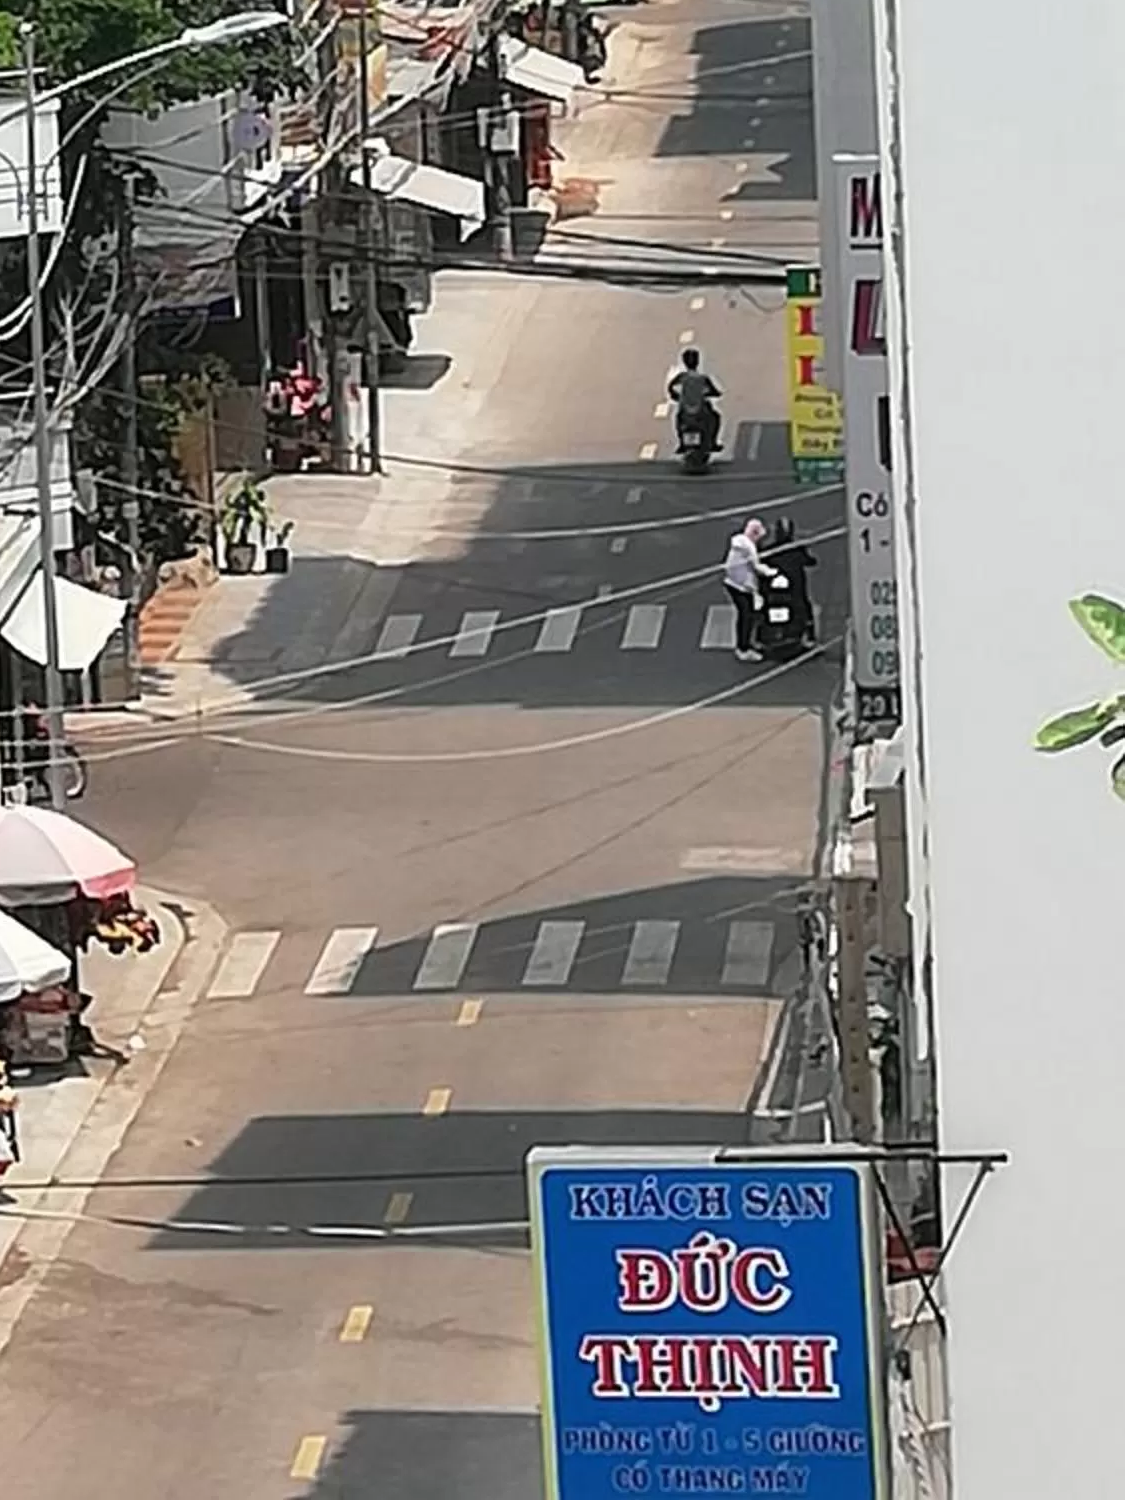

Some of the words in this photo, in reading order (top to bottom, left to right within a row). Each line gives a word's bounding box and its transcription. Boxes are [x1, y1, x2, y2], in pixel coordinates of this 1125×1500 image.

[569, 1174, 731, 1220] KHÁCH
[742, 1182, 832, 1227] SẠN
[616, 1231, 792, 1312] ĐỨC
[579, 1333, 840, 1412] THỊNH
